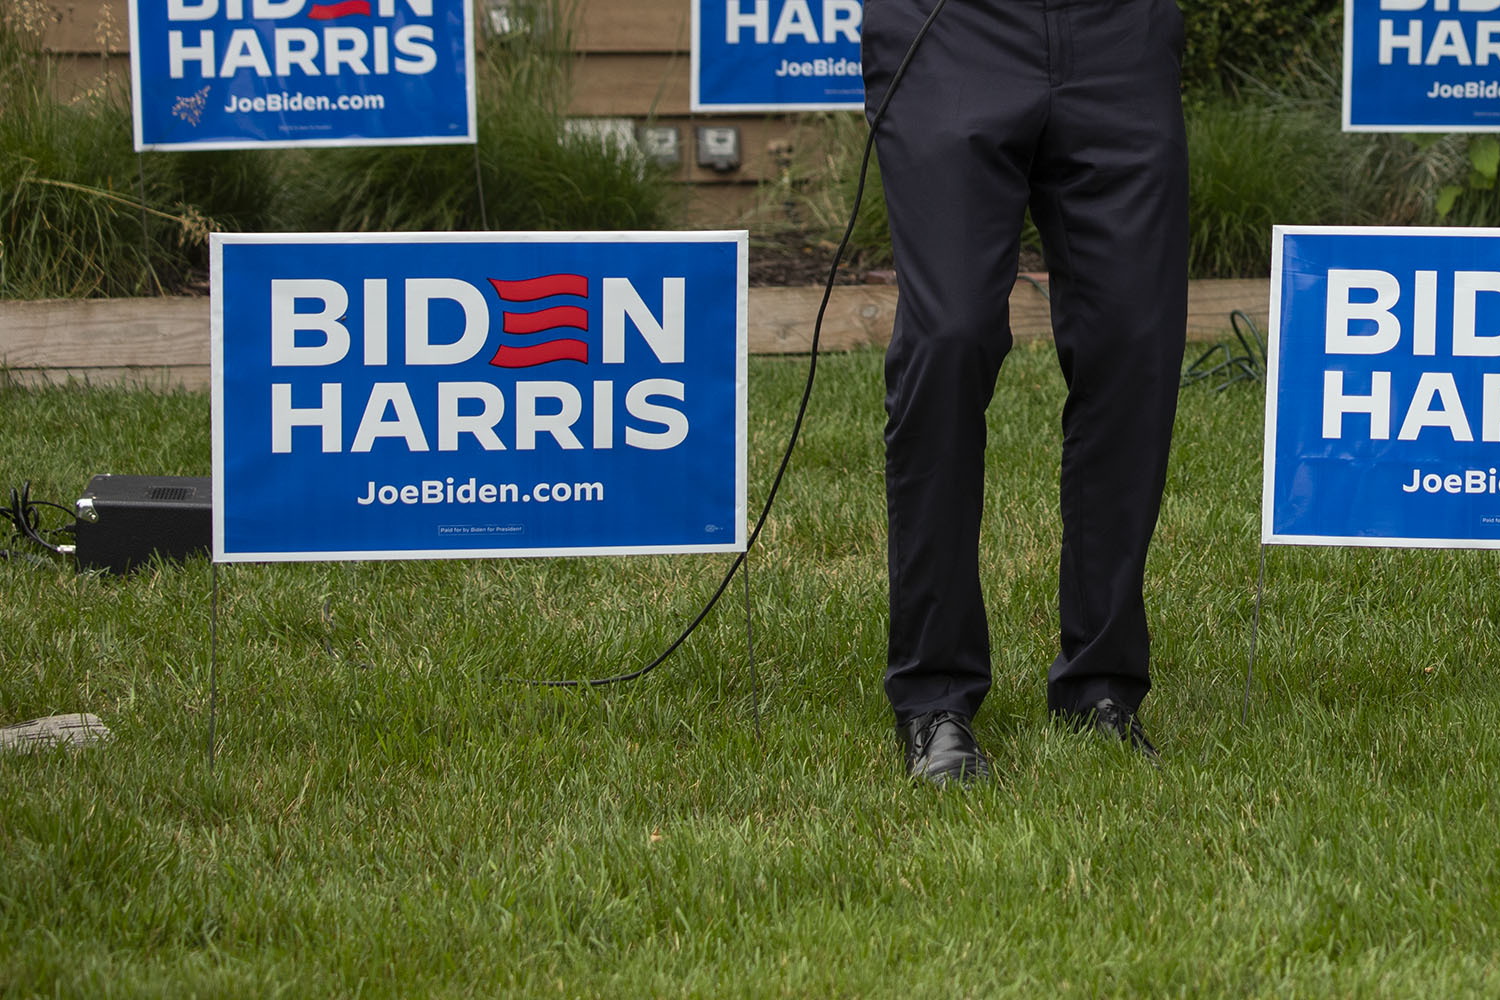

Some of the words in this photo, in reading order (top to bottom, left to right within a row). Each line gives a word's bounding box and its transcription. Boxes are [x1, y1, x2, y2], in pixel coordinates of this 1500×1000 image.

[168, 25, 438, 79] HARRIS
[224, 91, 385, 114] JoeBiden.com
[271, 273, 686, 368] BIDEN
[271, 380, 690, 455] HARRIS
[357, 477, 605, 507] JoeBiden.com
